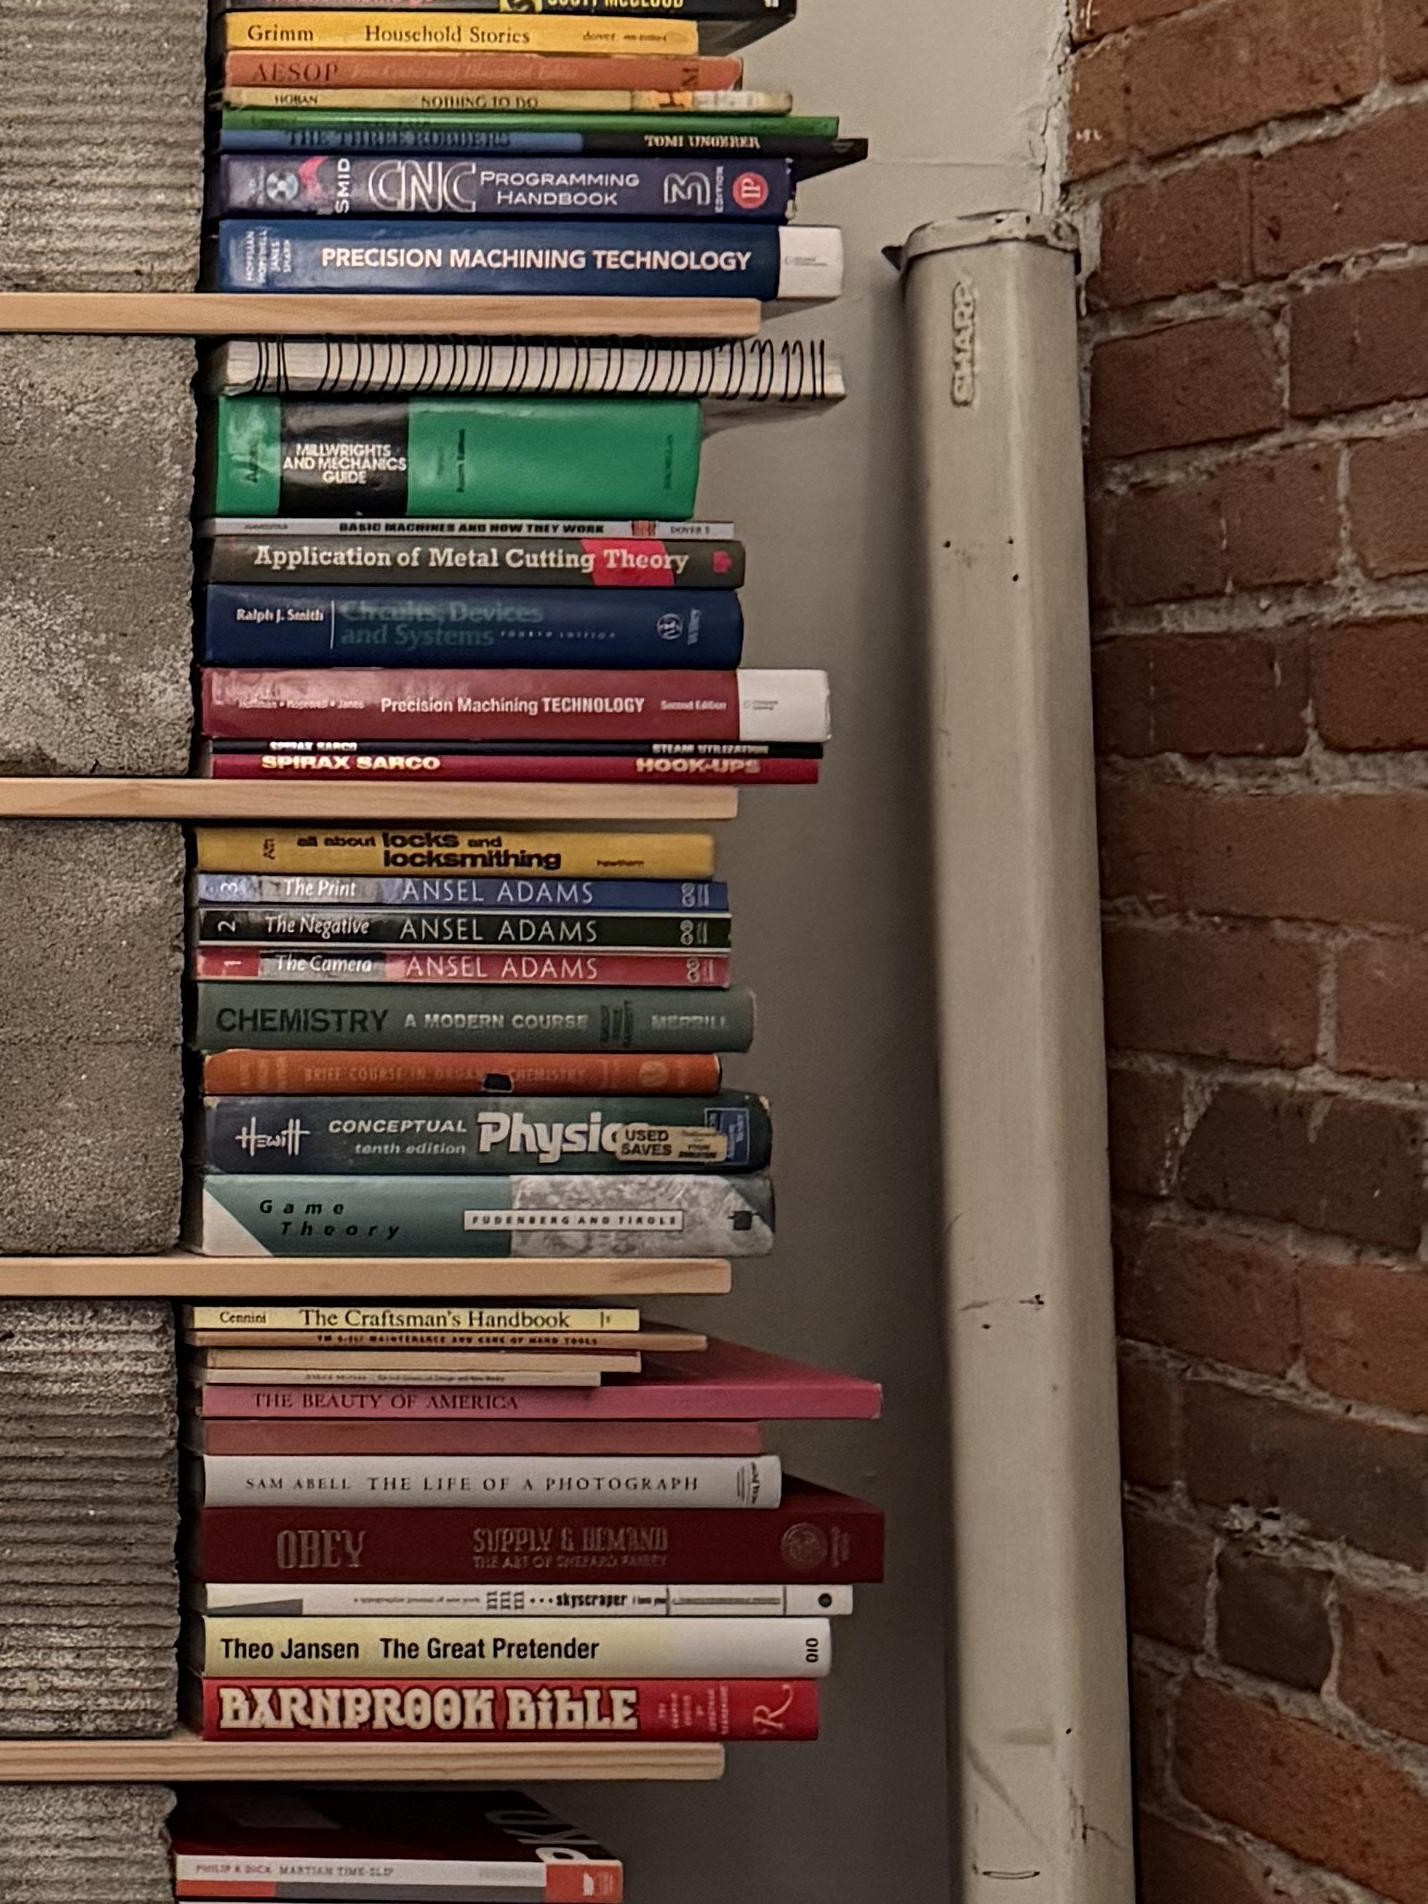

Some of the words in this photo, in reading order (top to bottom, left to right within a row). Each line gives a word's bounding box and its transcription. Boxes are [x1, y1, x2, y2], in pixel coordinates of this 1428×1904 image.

[322, 249, 439, 268] PRECISION
[449, 249, 584, 269] MACHINING
[593, 251, 751, 271] TECHNOLOGY
[255, 546, 390, 570] Application
[397, 547, 418, 566] of
[429, 547, 498, 568] Metal
[505, 549, 594, 573] Cutting
[603, 549, 688, 574] Theory
[383, 850, 561, 871] locksmithing
[402, 882, 484, 902] ANSEL
[497, 883, 592, 903] ADAMS
[216, 1007, 389, 1034] CHEMISTRY
[328, 1120, 466, 1134] CONCEPTUAL
[624, 1130, 669, 1144] USED
[621, 1143, 671, 1156] SAVES
[277, 1530, 365, 1568] OBEY
[221, 1638, 273, 1659] Theo
[280, 1637, 359, 1660] Jansen
[380, 1638, 420, 1659] The
[426, 1638, 485, 1659] Great
[491, 1638, 599, 1659] Pretender
